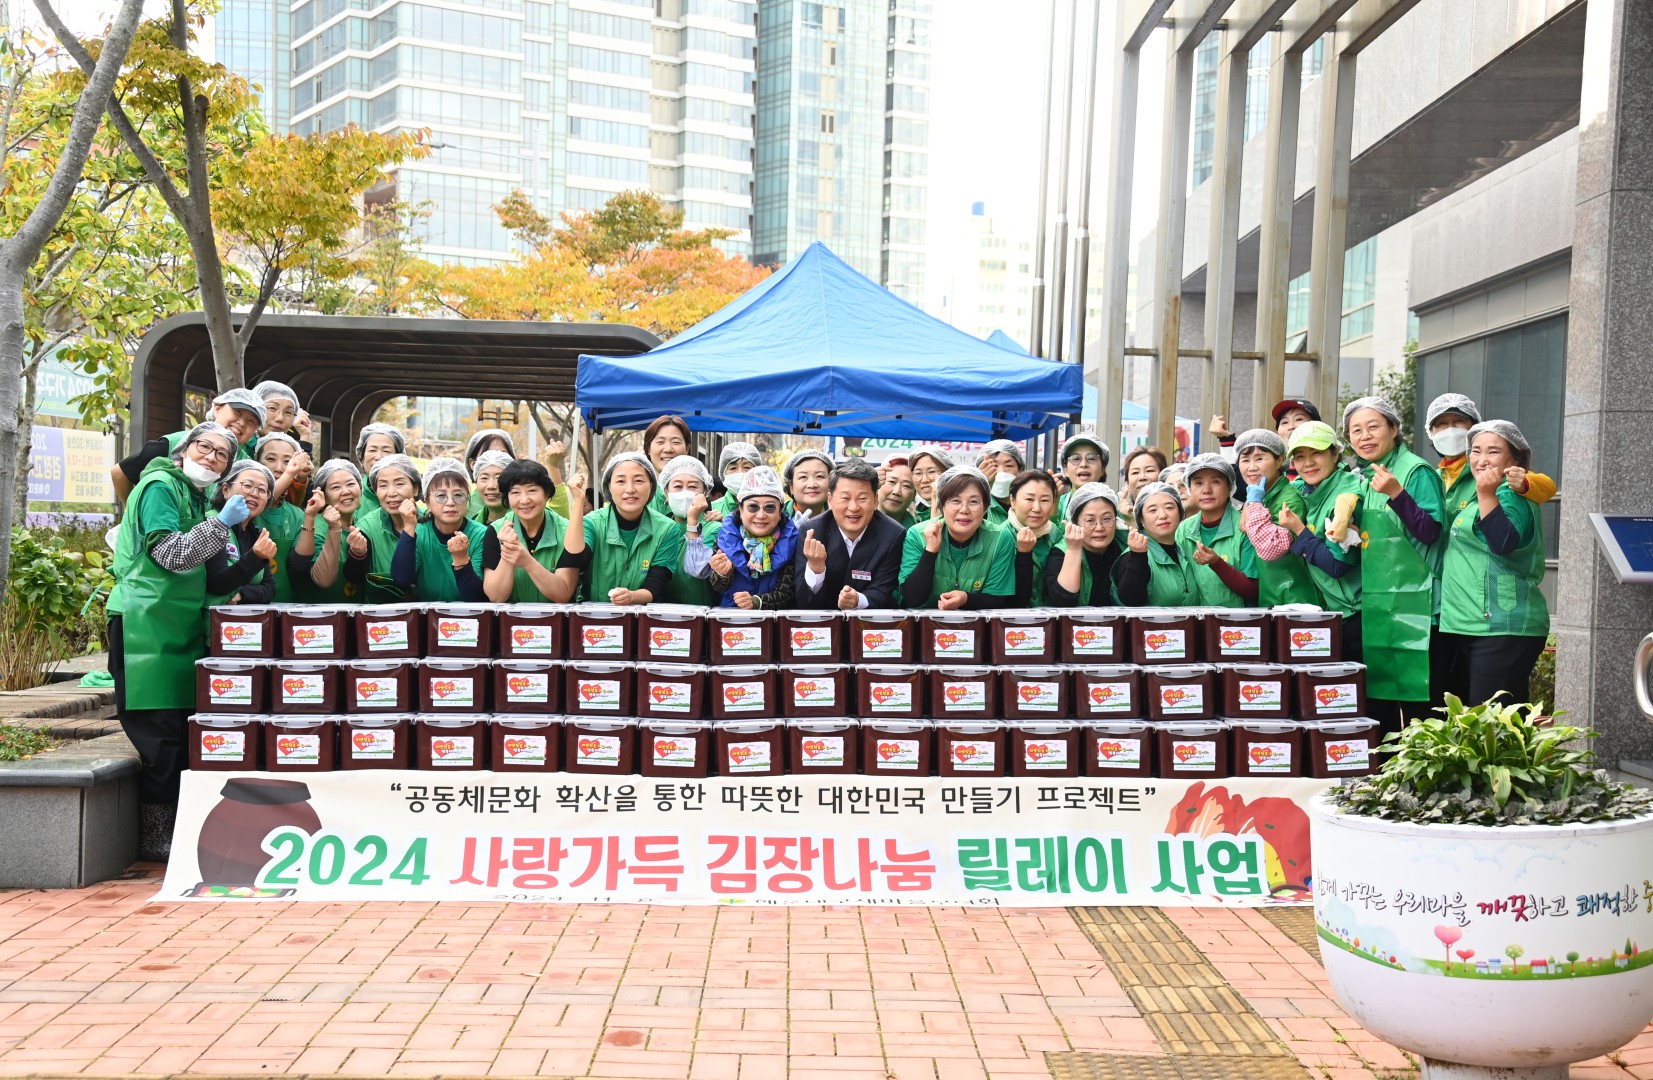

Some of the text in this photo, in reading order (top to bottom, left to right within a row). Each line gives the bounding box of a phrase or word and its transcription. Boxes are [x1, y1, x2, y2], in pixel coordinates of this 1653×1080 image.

[391, 783, 1156, 815] “공동체문화 확산을 통한 따뜻한 대한민국 만들기 프로젝트”
[264, 832, 1263, 896] 2024 사랑가득 김장나눔 릴레이 사업
[1342, 882, 1388, 911] 가꾸는
[1392, 889, 1472, 927] 우리마을
[1477, 894, 1569, 922] 깨끗하고
[1576, 884, 1638, 917] 쾌적한
